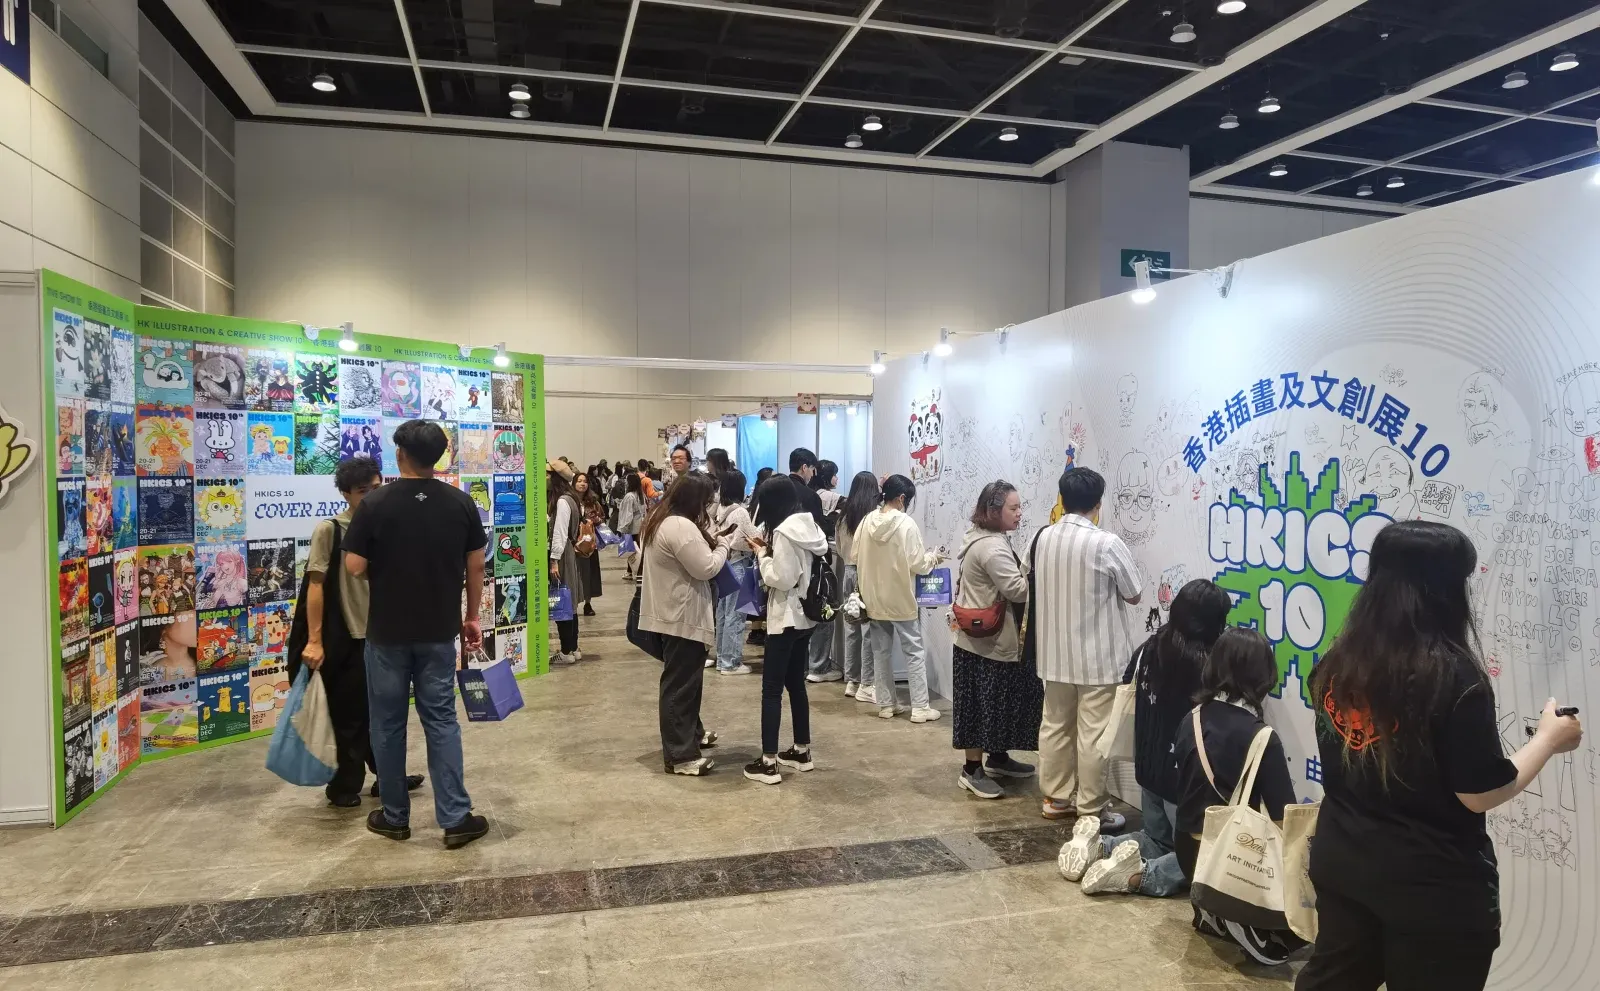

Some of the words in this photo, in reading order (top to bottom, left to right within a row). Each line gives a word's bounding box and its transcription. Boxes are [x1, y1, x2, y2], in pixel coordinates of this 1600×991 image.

[138, 320, 150, 328] HK
[153, 322, 216, 335] ILLUSTRATION
[228, 330, 266, 341] CREATIVE
[269, 334, 294, 345] SHOW
[404, 350, 448, 359] ILLUSTRATION
[340, 358, 364, 366] HKICS
[196, 412, 226, 420] HKICS
[140, 479, 172, 487] HKICS
[255, 502, 312, 519] COVER
[1569, 503, 1600, 522] XUE
[1544, 546, 1574, 564] JOE
[1544, 566, 1598, 588] AKIRA
[1552, 588, 1588, 608] KEKE
[199, 610, 228, 620] HKICS
[1258, 578, 1326, 650] 10
[142, 616, 175, 626] HKICS
[252, 666, 279, 677] HKICS
[200, 675, 229, 686] HKICS
[144, 684, 176, 696] HKICS
[475, 691, 484, 699] 10
[1227, 854, 1241, 864] ART
